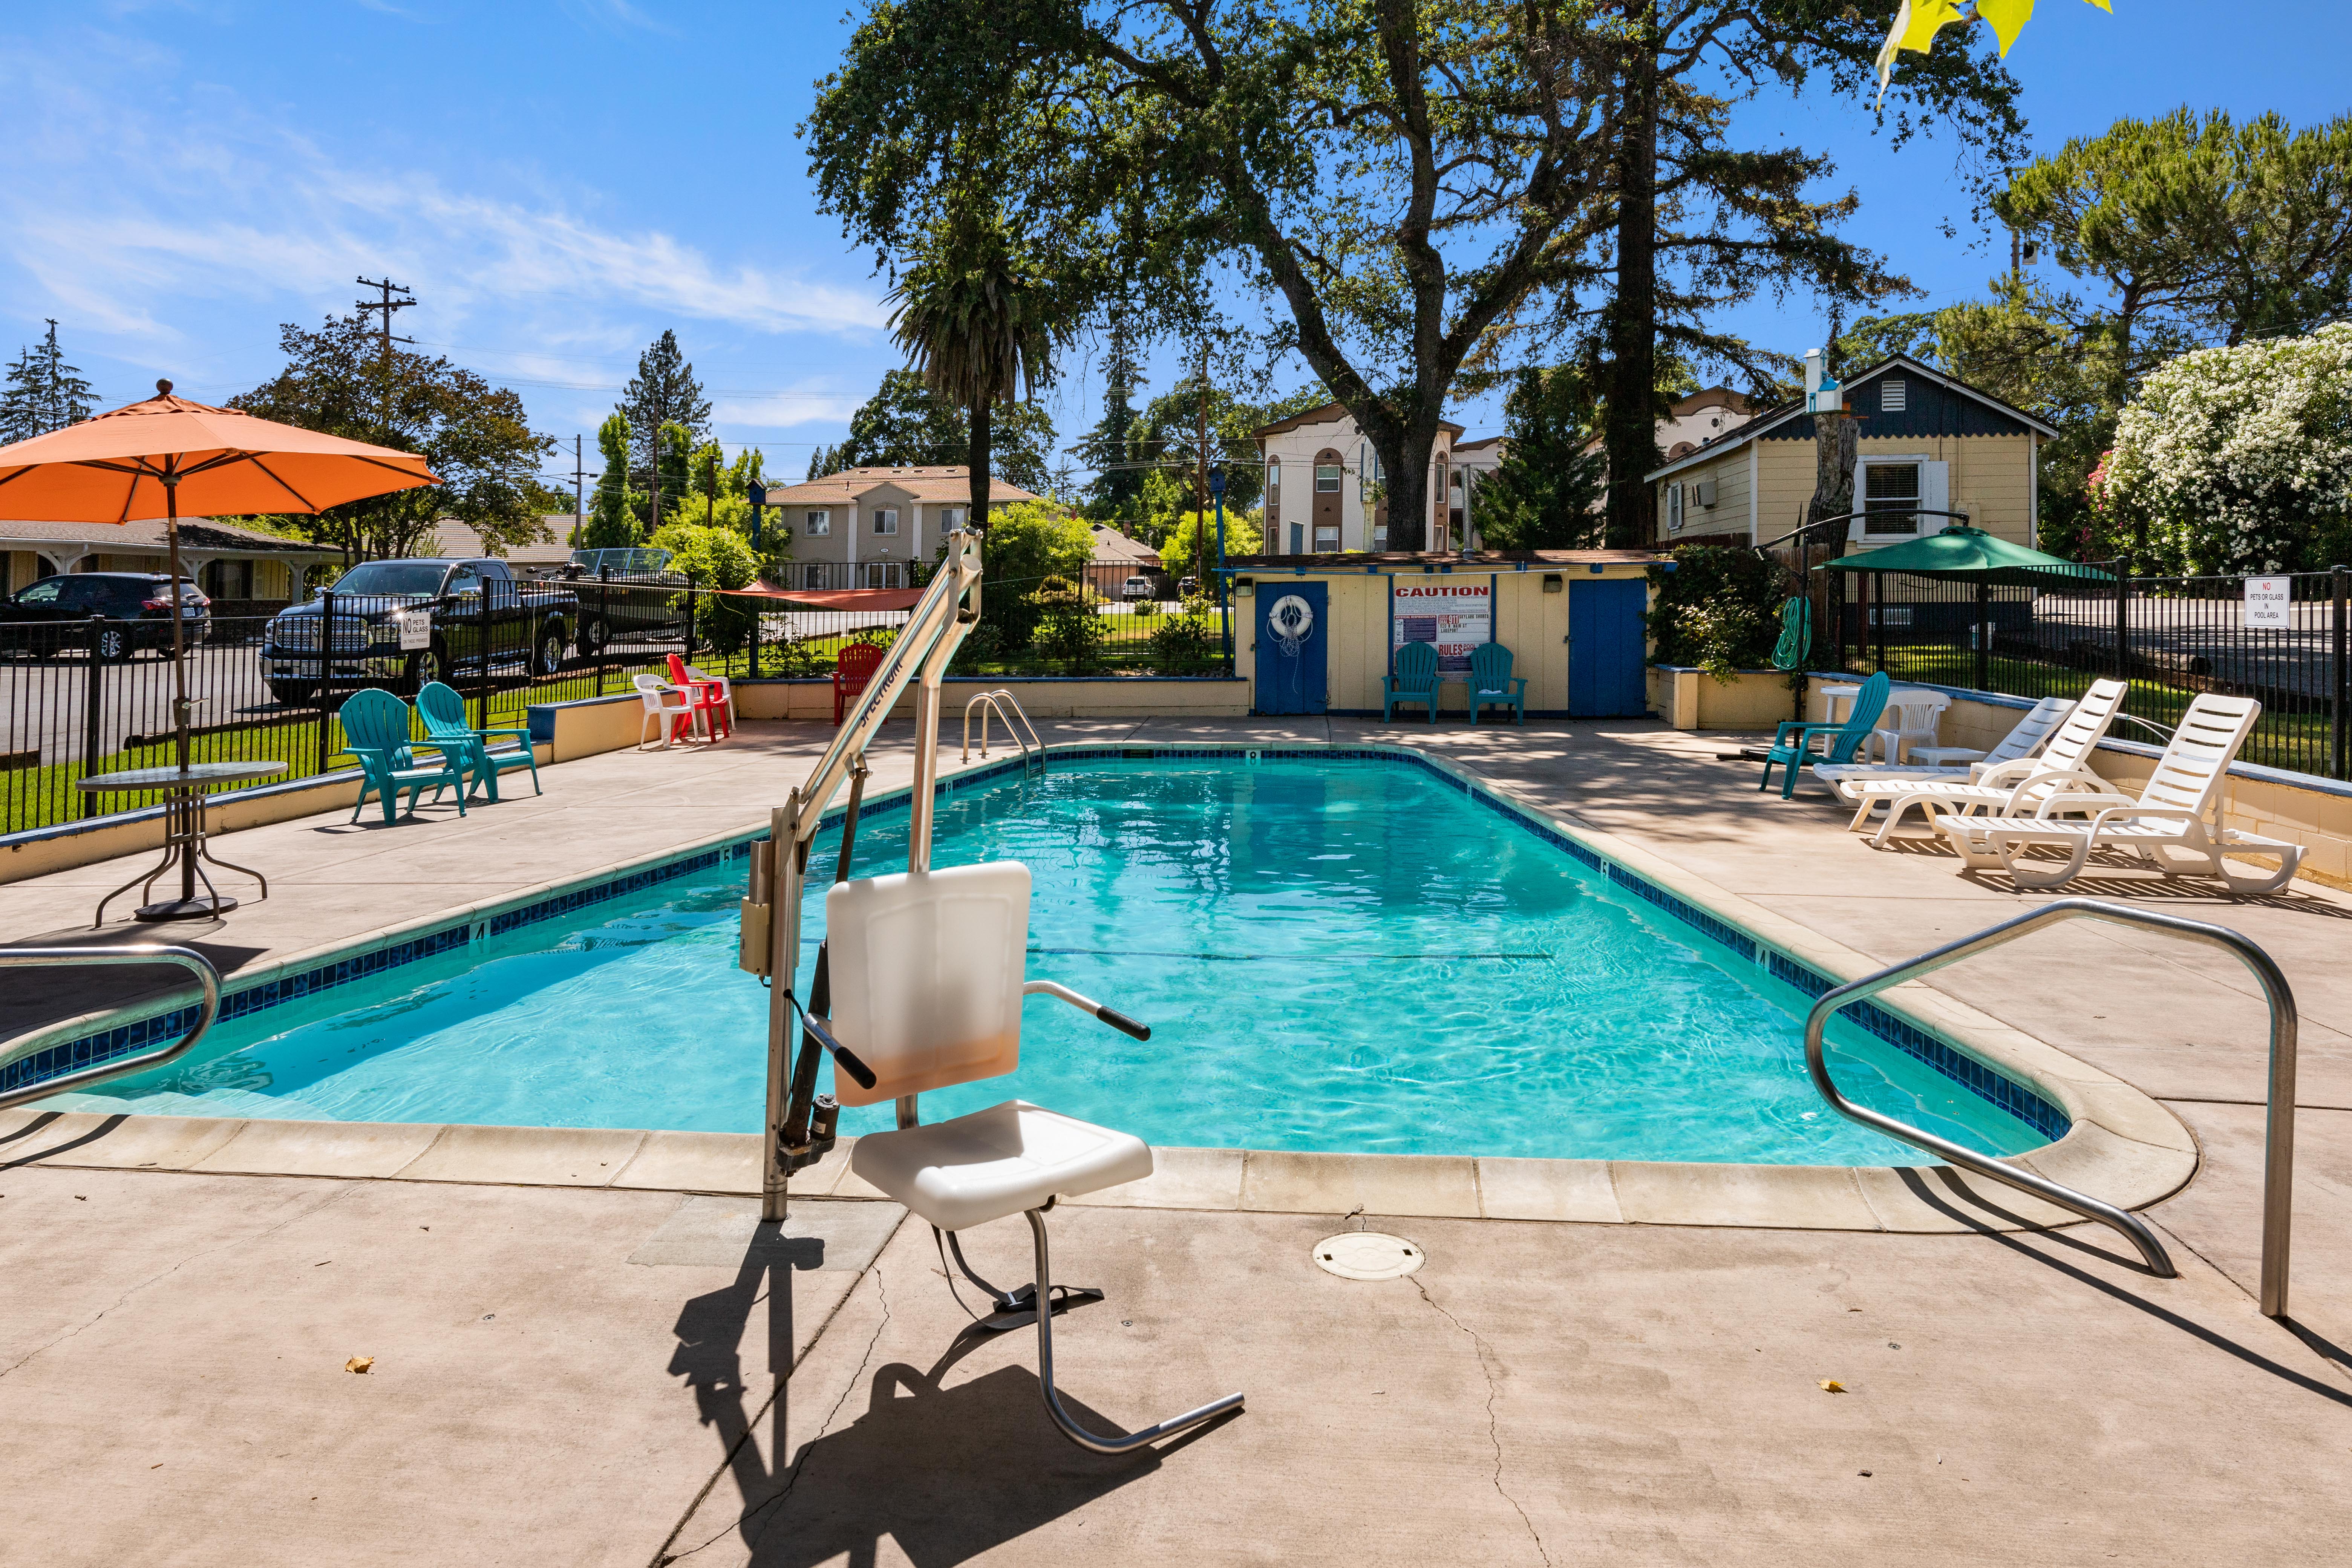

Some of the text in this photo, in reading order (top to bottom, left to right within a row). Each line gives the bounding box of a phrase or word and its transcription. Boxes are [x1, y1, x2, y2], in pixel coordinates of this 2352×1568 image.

[1396, 586, 1488, 597] CAUTION
[403, 617, 412, 634] NO
[1449, 615, 1459, 624] 911
[1439, 644, 1462, 655] RULES
[724, 848, 730, 863] 5
[1603, 861, 1606, 876] 5
